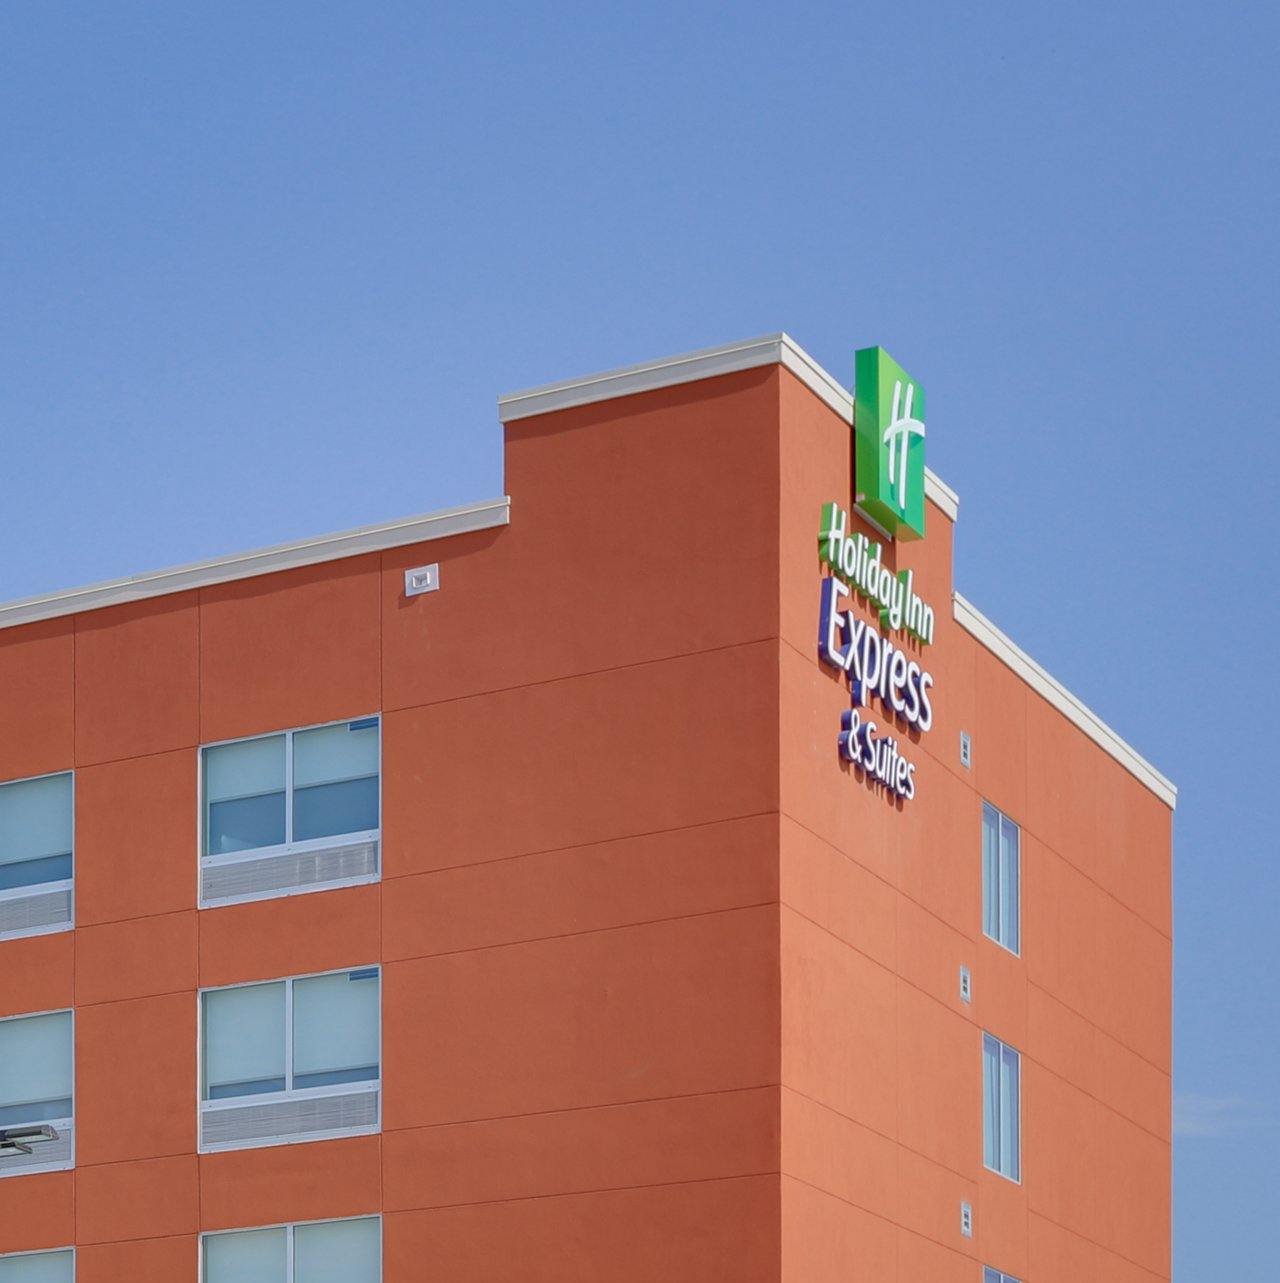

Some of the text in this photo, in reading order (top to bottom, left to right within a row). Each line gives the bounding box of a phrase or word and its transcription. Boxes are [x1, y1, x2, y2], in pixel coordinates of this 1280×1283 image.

[826, 502, 935, 646] Holiday Inn
[827, 576, 934, 733] Express
[846, 708, 916, 801] & Suites
